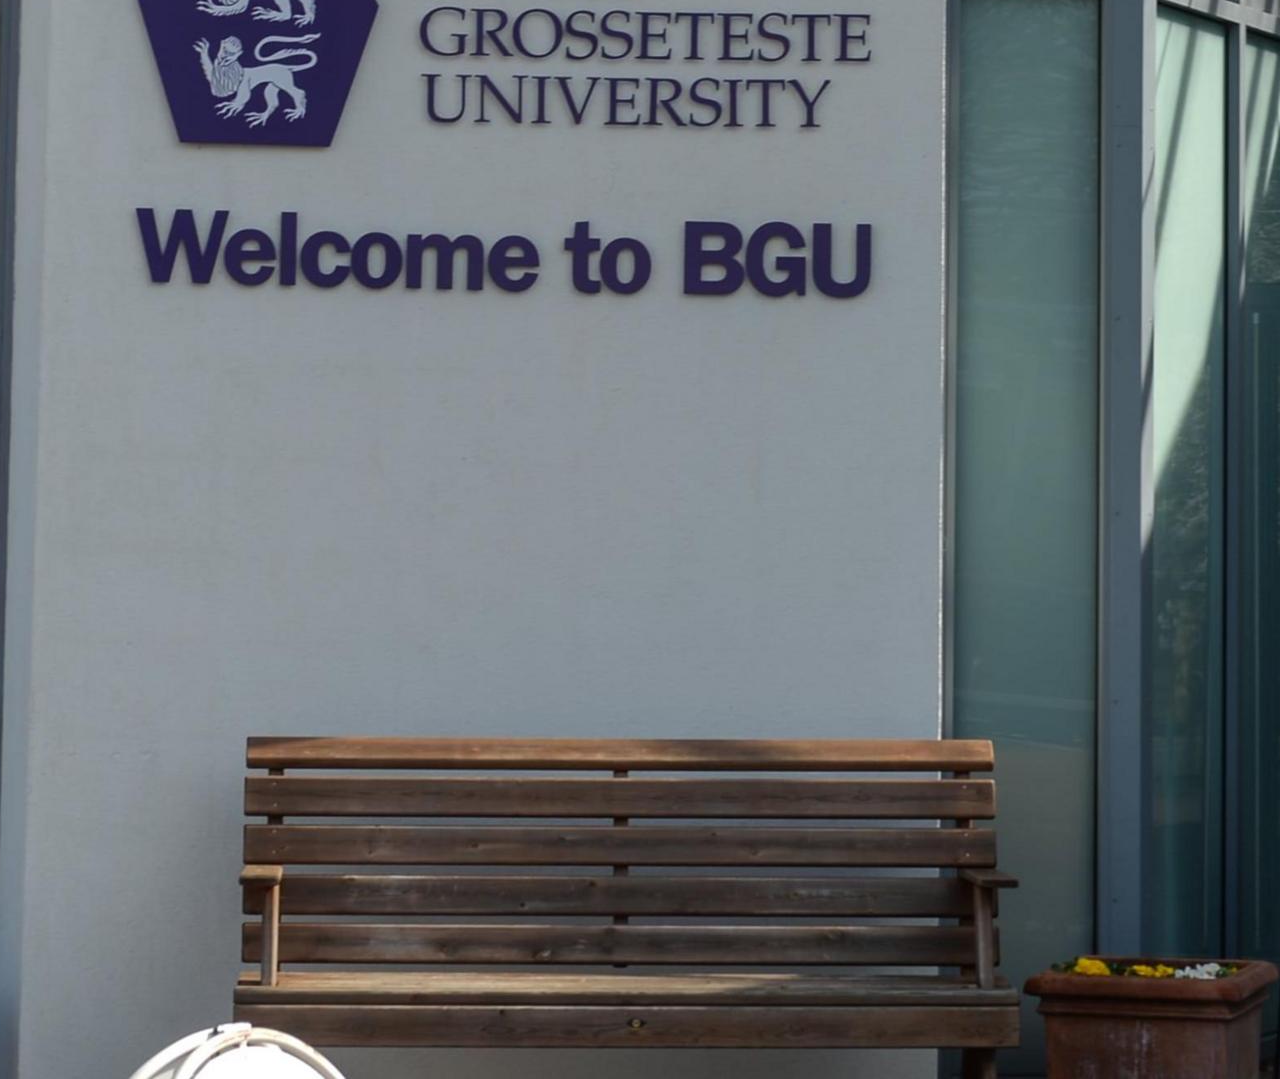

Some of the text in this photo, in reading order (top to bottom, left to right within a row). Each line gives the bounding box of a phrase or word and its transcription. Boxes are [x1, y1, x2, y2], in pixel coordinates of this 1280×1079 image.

[418, 7, 872, 63] GROSSETESTE
[420, 73, 832, 129] UNIVERSITY
[136, 207, 872, 298] Welcome to BGU
